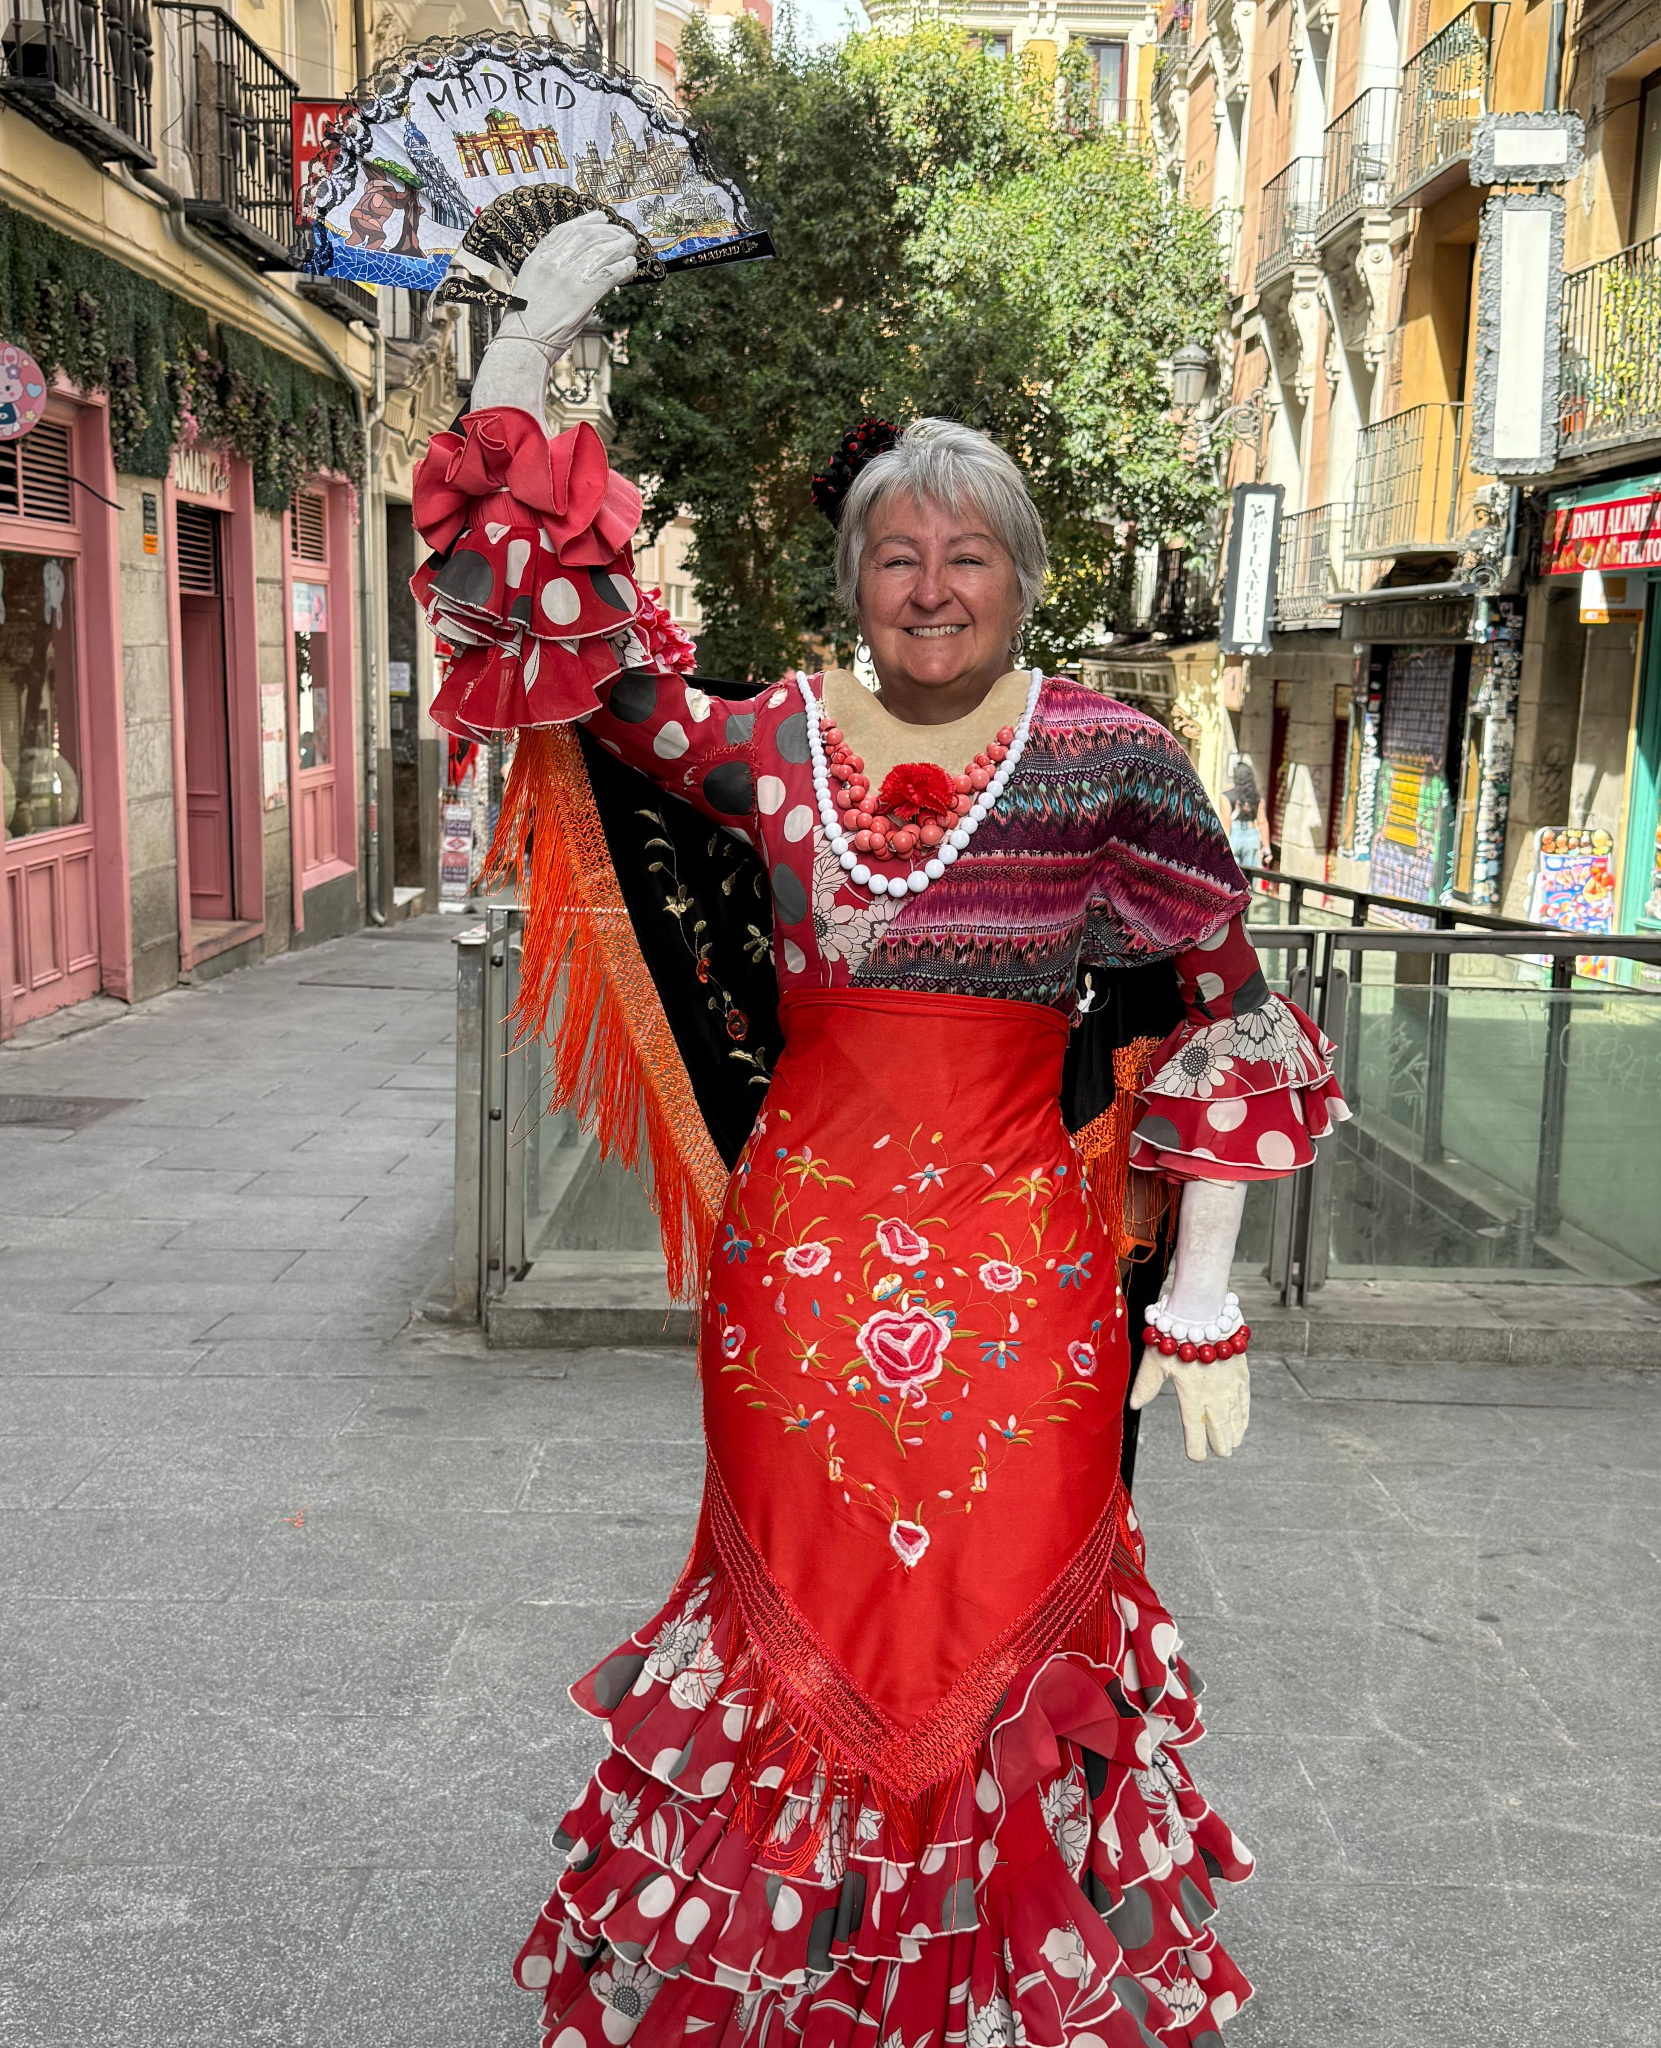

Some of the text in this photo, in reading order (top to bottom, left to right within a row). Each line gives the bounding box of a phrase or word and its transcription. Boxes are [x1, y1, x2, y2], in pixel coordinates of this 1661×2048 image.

[426, 71, 576, 122] MADRID
[697, 245, 740, 263] MADRID
[1572, 509, 1606, 539] DIMI
[1241, 531, 1265, 639] FILATELIA
